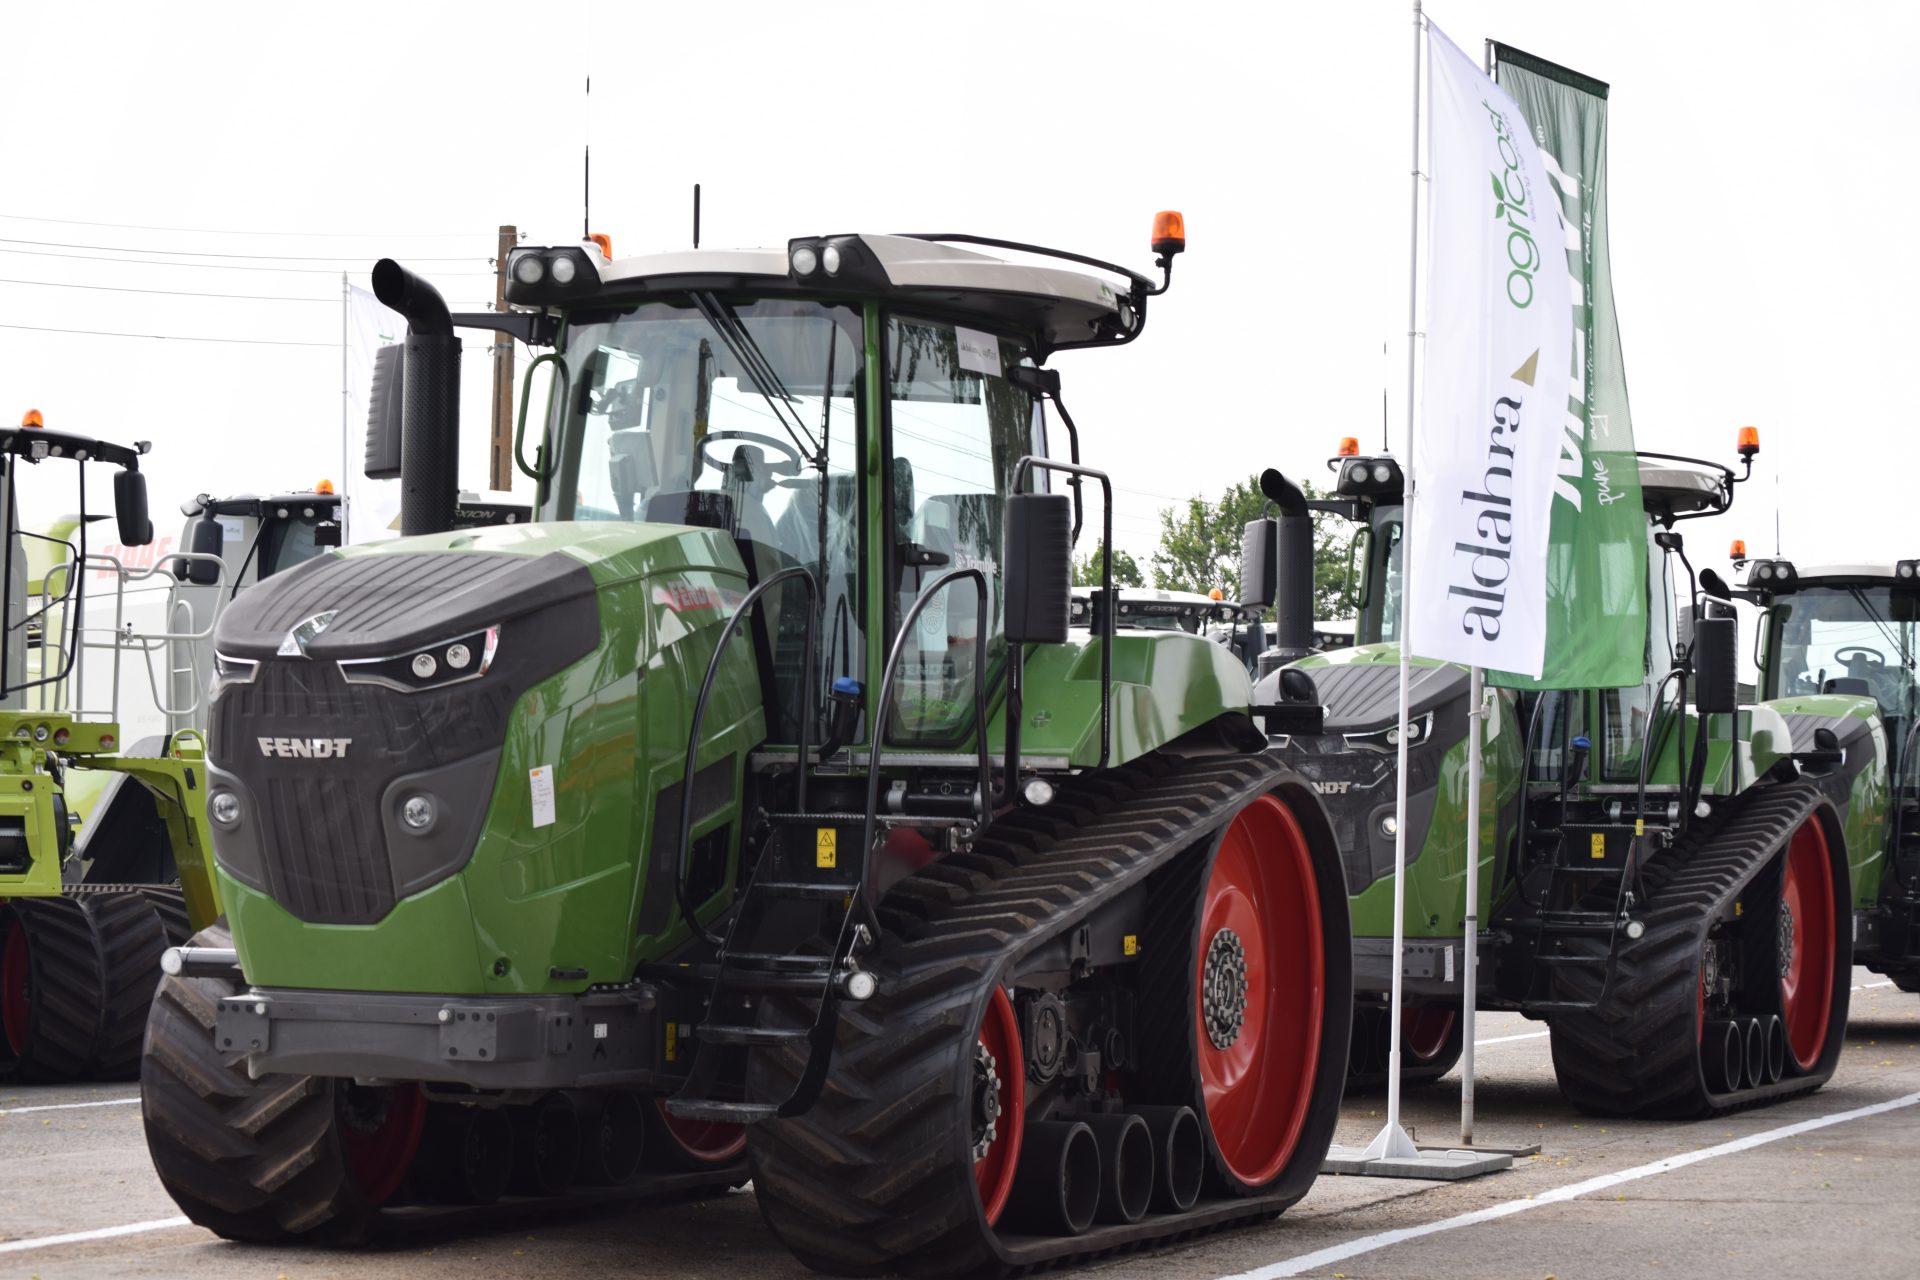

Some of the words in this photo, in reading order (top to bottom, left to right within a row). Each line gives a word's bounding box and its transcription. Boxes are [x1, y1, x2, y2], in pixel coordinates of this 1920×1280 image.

[1482, 98, 1541, 309] agricost
[1592, 457, 1626, 506] pune
[1447, 395, 1523, 642] aldahra
[257, 736, 353, 759] FENDT
[1311, 781, 1352, 795] NDT
